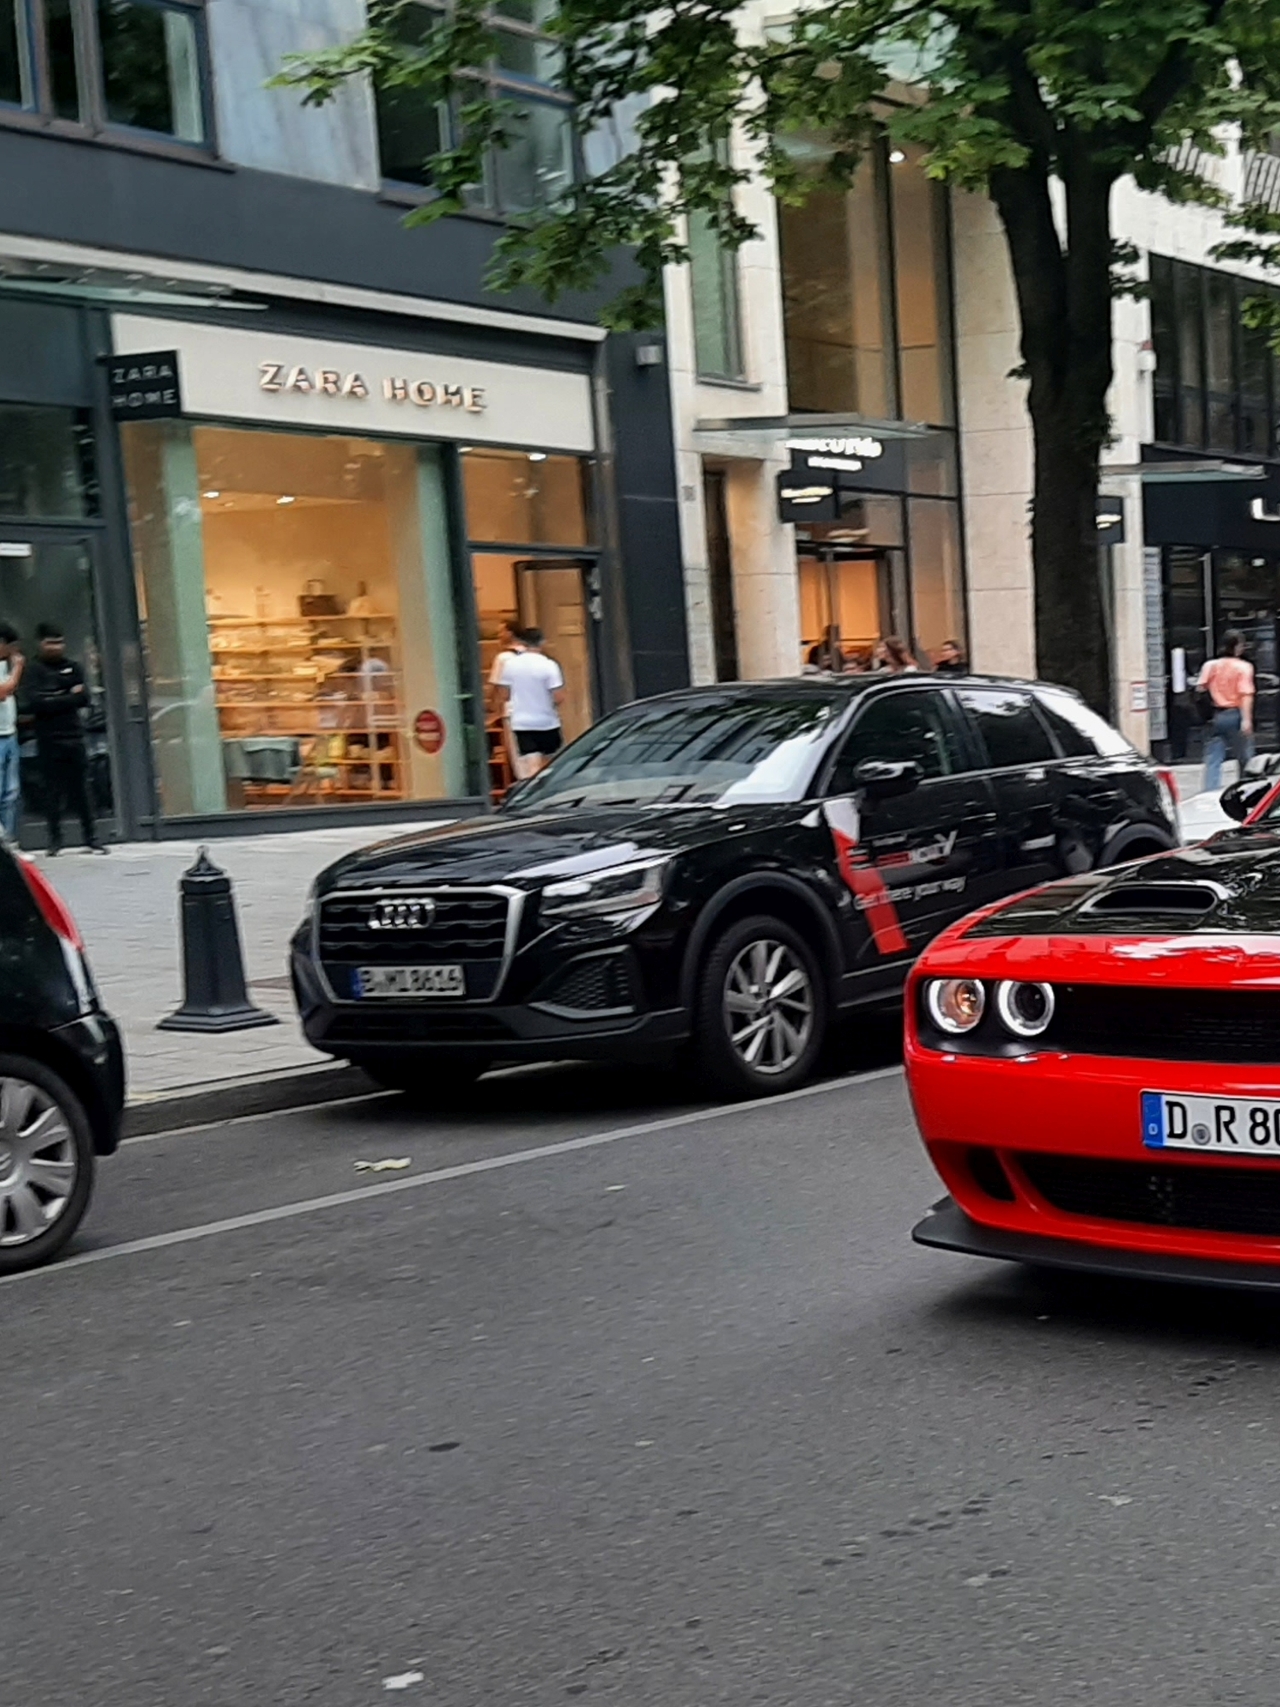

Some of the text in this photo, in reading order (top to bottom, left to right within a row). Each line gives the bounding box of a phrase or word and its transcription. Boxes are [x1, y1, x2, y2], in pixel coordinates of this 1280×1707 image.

[112, 364, 173, 384] ZARA
[259, 361, 487, 413] ZARA HOME
[112, 388, 176, 408] HOME
[1166, 1100, 1188, 1140] D
[1214, 1104, 1239, 1145] R
